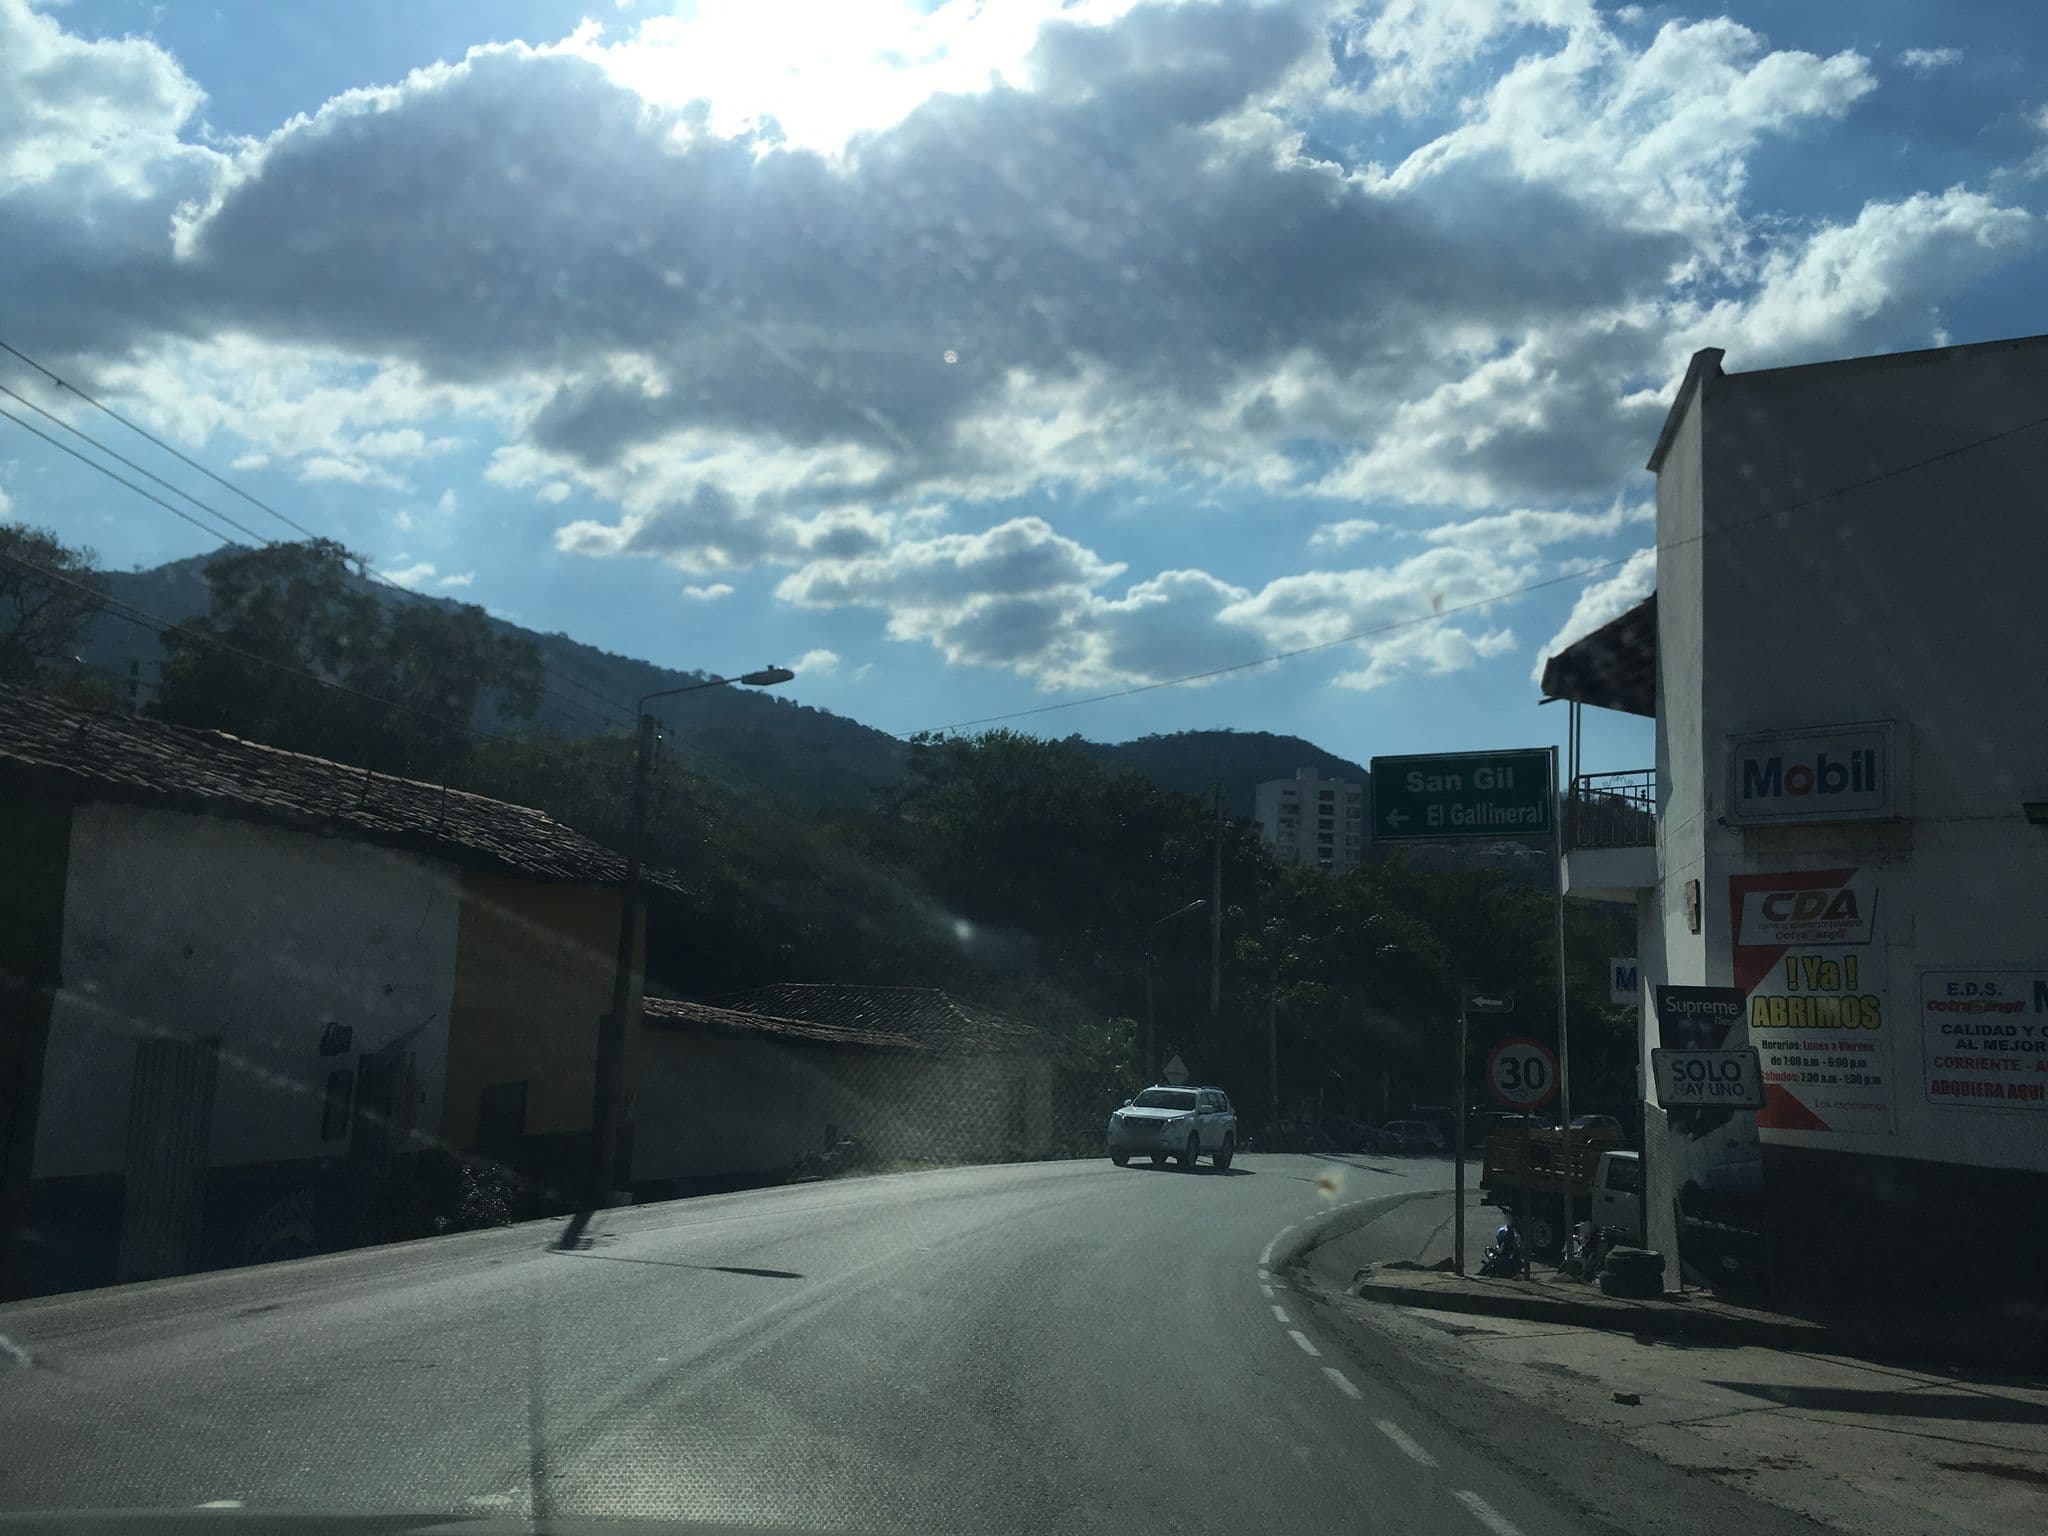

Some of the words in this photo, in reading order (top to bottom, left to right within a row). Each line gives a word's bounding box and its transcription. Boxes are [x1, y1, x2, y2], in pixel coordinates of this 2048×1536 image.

[1405, 770, 1462, 793] San
[1472, 766, 1515, 790] Gil
[1743, 750, 1875, 799] Mobil
[1426, 804, 1445, 827] El
[1450, 802, 1544, 826] Gallineral
[1762, 889, 1860, 921] CDA
[1946, 982, 2003, 996] E.D.S.
[1665, 995, 1739, 1018] Supreme
[1752, 995, 1881, 1030] ABRIMOS
[1941, 1023, 2017, 1037] CALIDAD
[2022, 1025, 2034, 1036] Y
[1956, 1039, 1978, 1050] AL
[1984, 1040, 2046, 1052] MEJOR
[1671, 1059, 1742, 1083] SOLO
[1770, 1055, 1782, 1066] de
[1934, 1056, 2022, 1071] CORRIENTE
[1501, 1056, 1545, 1089] 30
[1710, 1083, 1745, 1097] UNO
